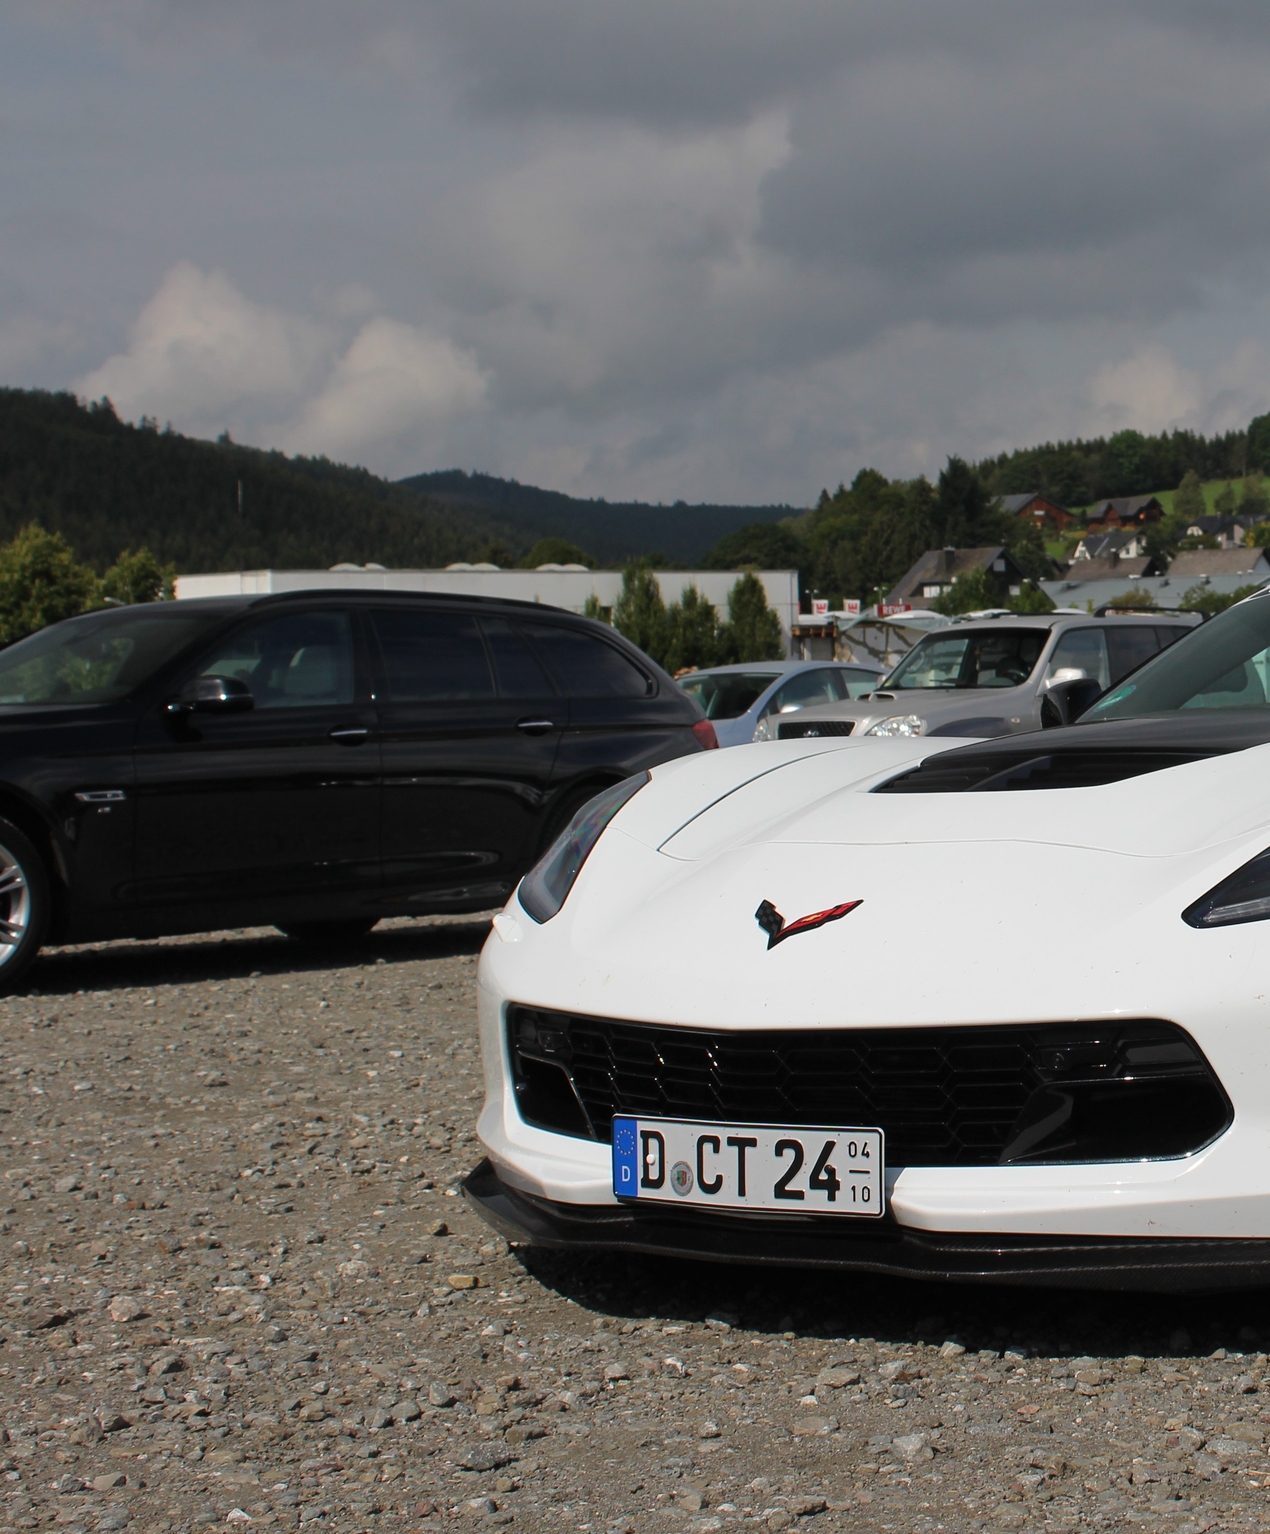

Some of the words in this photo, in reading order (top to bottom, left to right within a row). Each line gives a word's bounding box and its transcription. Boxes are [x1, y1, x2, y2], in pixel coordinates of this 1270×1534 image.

[848, 1141, 870, 1158] 04
[621, 1165, 631, 1182] D
[640, 1130, 665, 1189] D
[696, 1134, 757, 1197] CT
[774, 1139, 841, 1201] 24
[850, 1185, 871, 1202] 10
